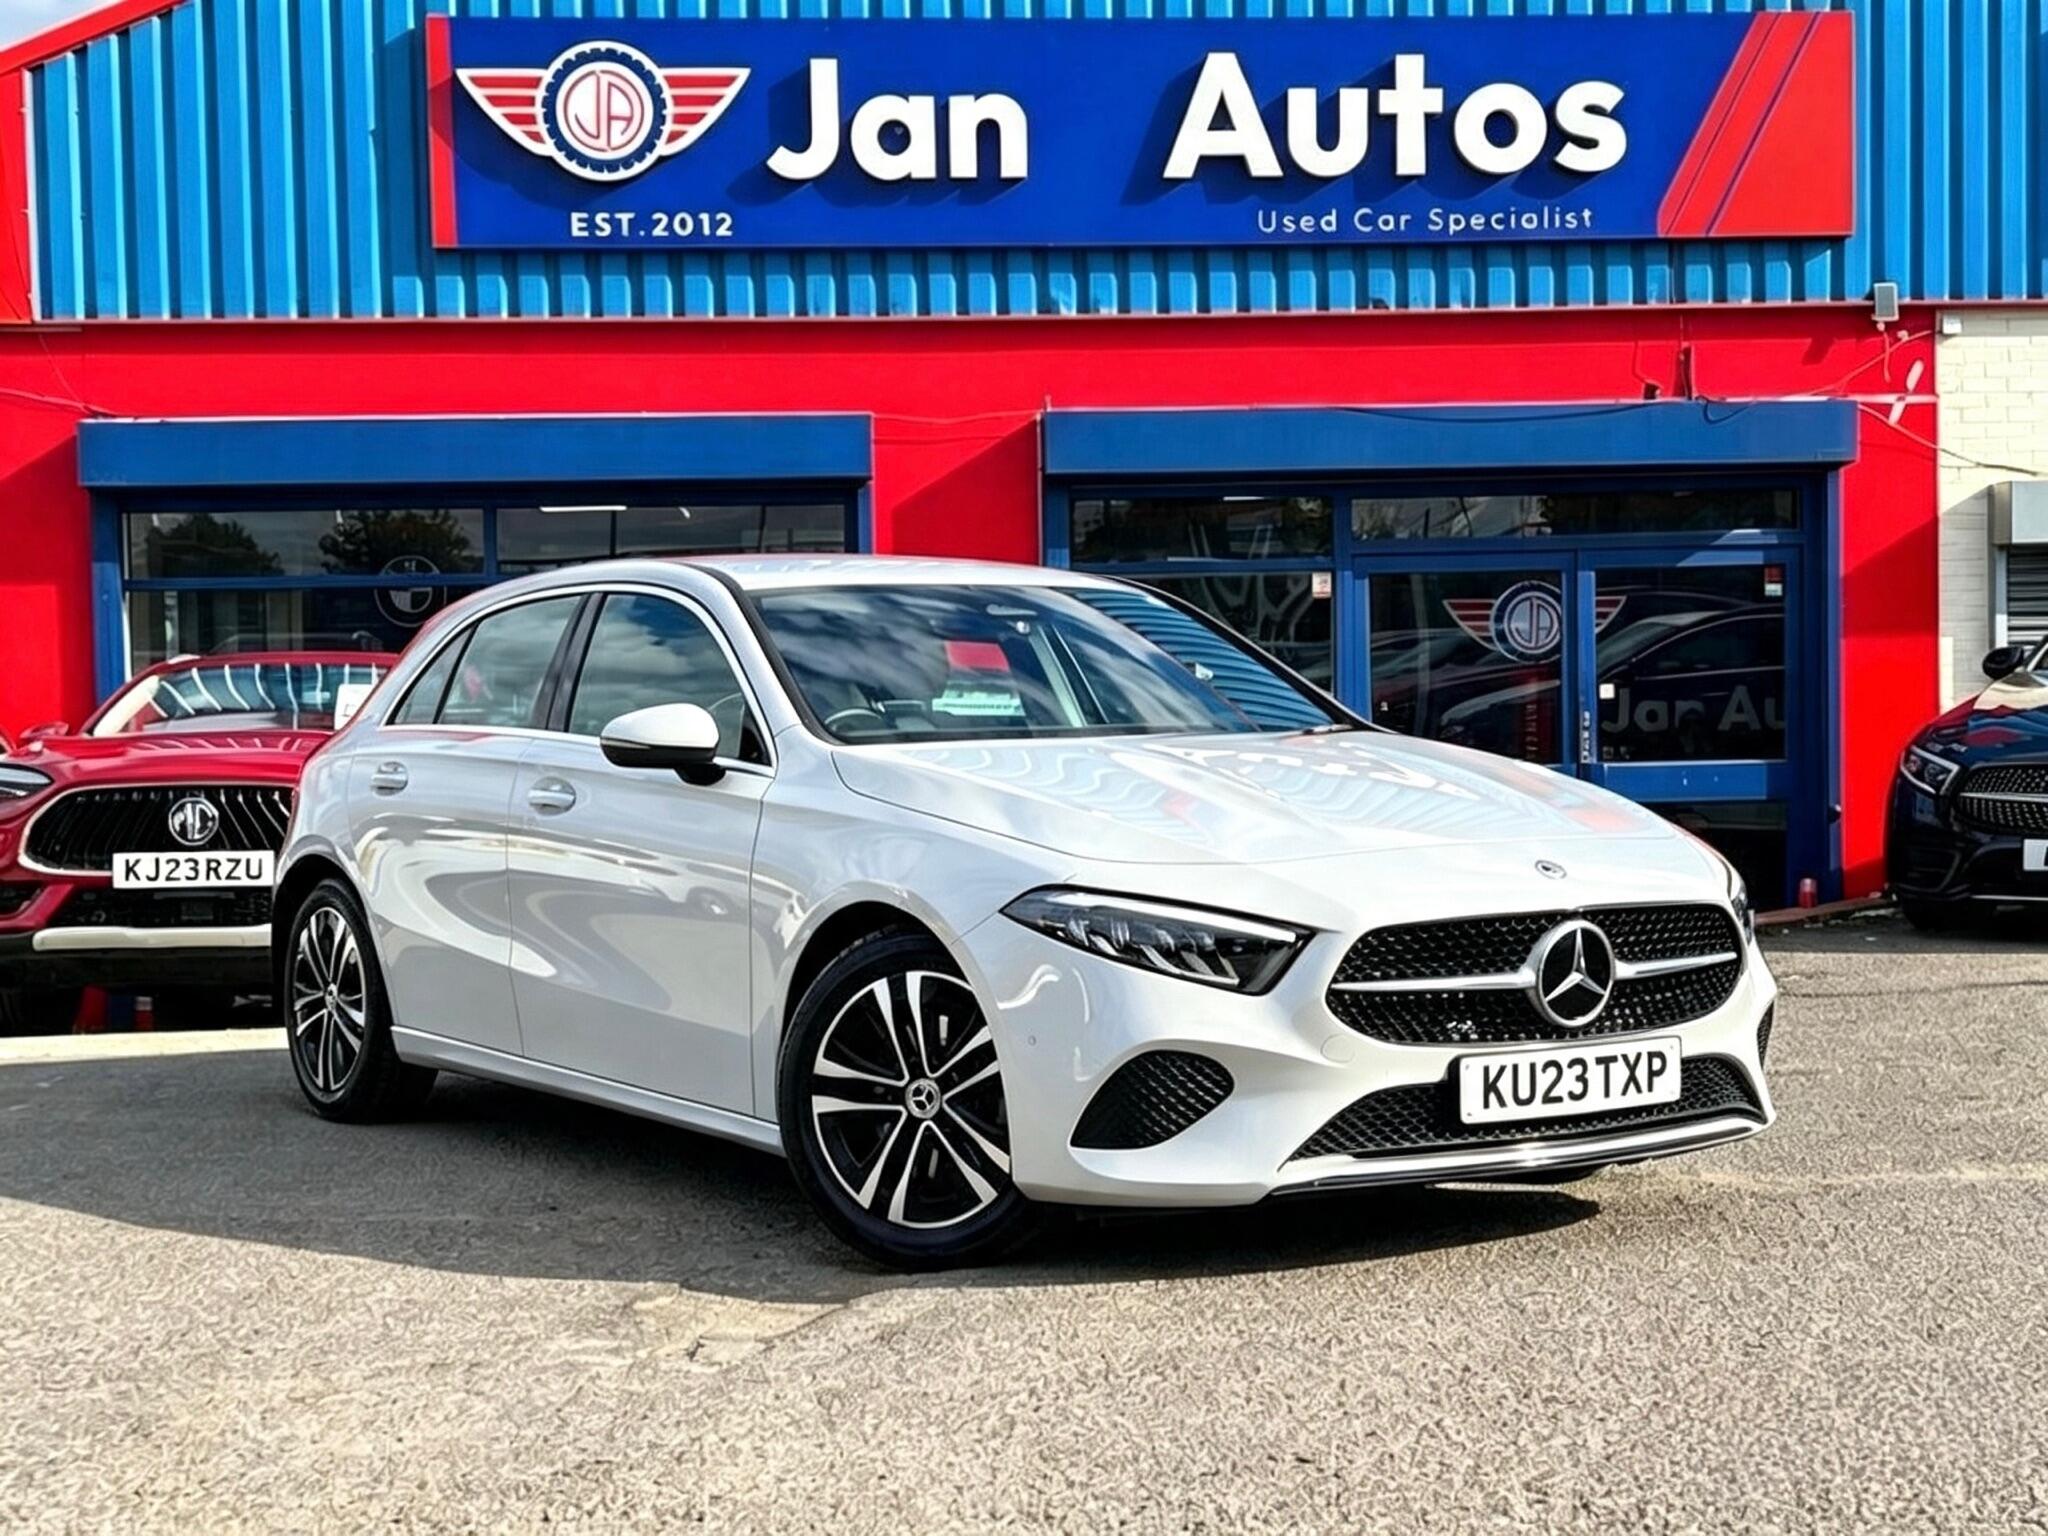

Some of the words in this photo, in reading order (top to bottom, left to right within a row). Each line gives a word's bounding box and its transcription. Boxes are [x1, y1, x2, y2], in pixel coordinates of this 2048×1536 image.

[766, 57, 1028, 181] Jan
[1162, 52, 1628, 180] Autos
[1257, 208, 1338, 233] Used
[1353, 207, 1412, 232] Car
[1427, 205, 1594, 236] Specialist
